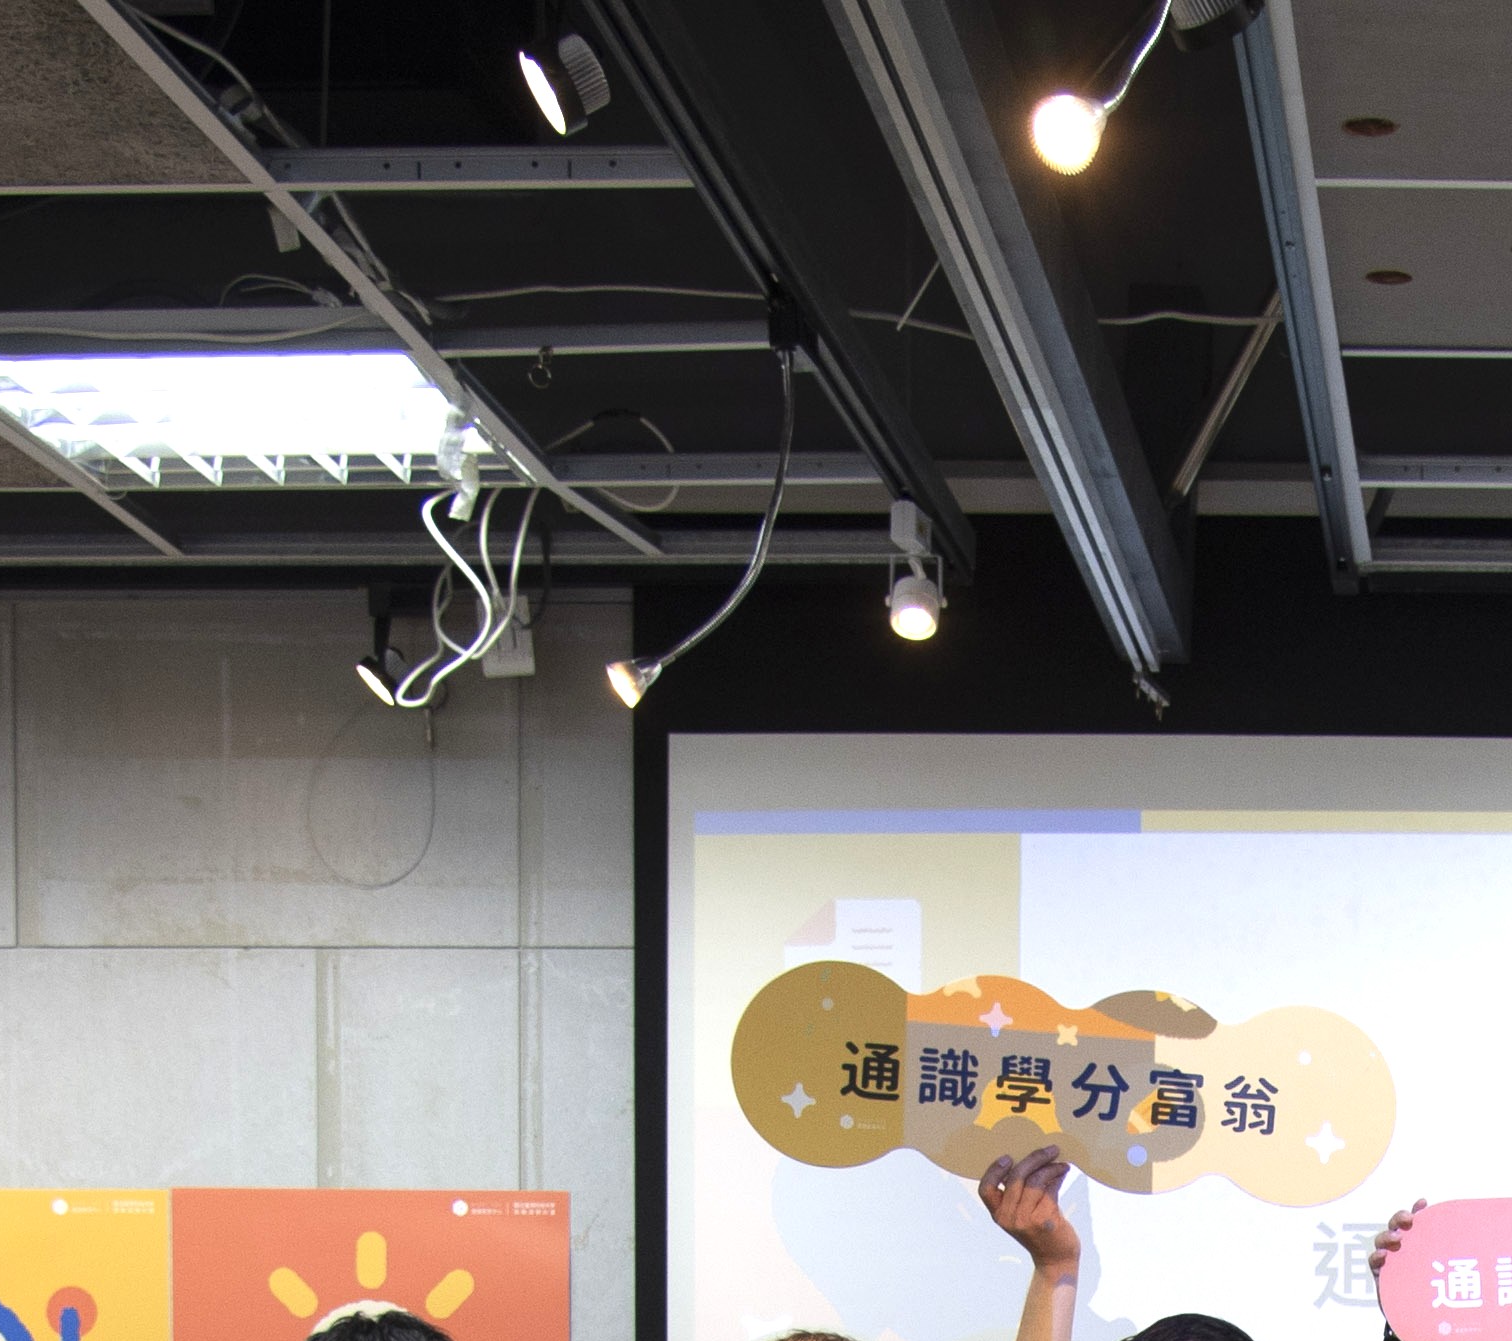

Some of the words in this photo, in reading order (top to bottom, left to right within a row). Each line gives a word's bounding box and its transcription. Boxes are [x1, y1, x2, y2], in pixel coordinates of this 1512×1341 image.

[840, 1041, 1279, 1136] 通識學分富翁
